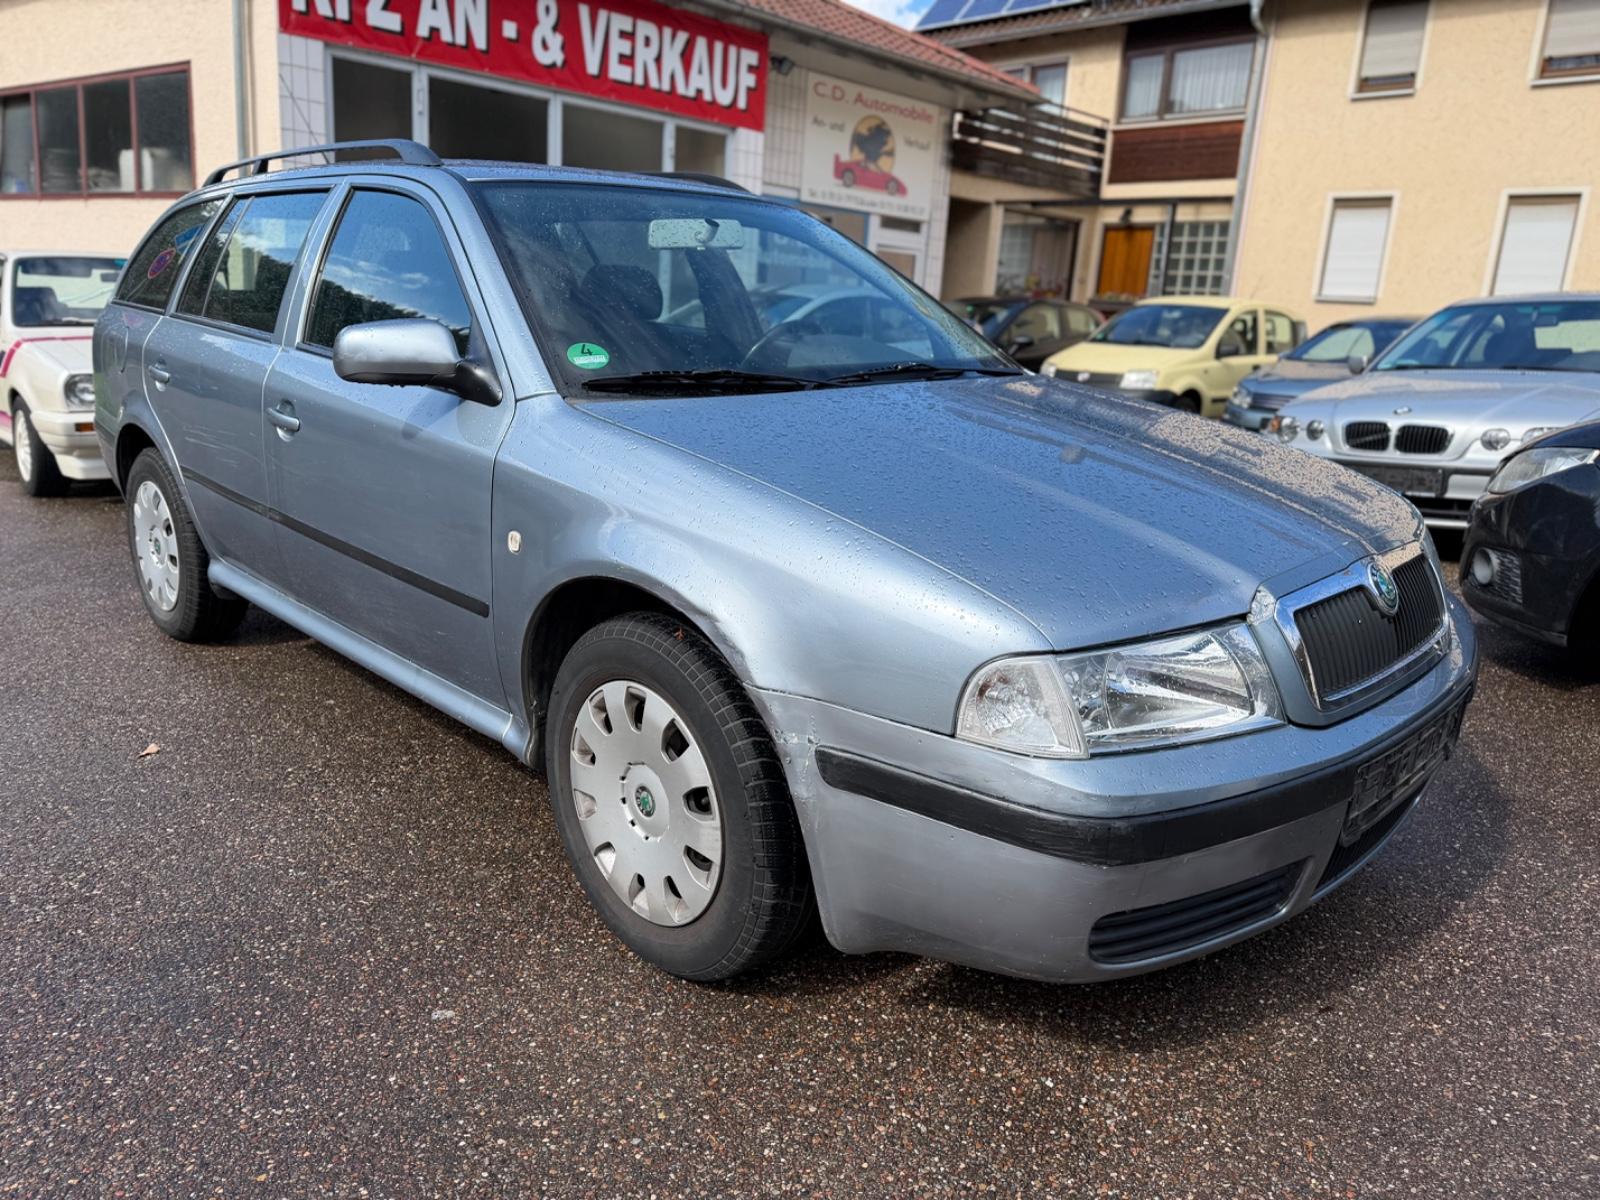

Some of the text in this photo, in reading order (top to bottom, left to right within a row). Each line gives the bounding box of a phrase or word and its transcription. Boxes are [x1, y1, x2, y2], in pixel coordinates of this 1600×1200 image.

[416, 0, 488, 51] AN
[532, 0, 565, 68] &
[578, 3, 760, 110] VERKAUF
[853, 92, 935, 125] Automobile
[581, 344, 593, 356] 4
